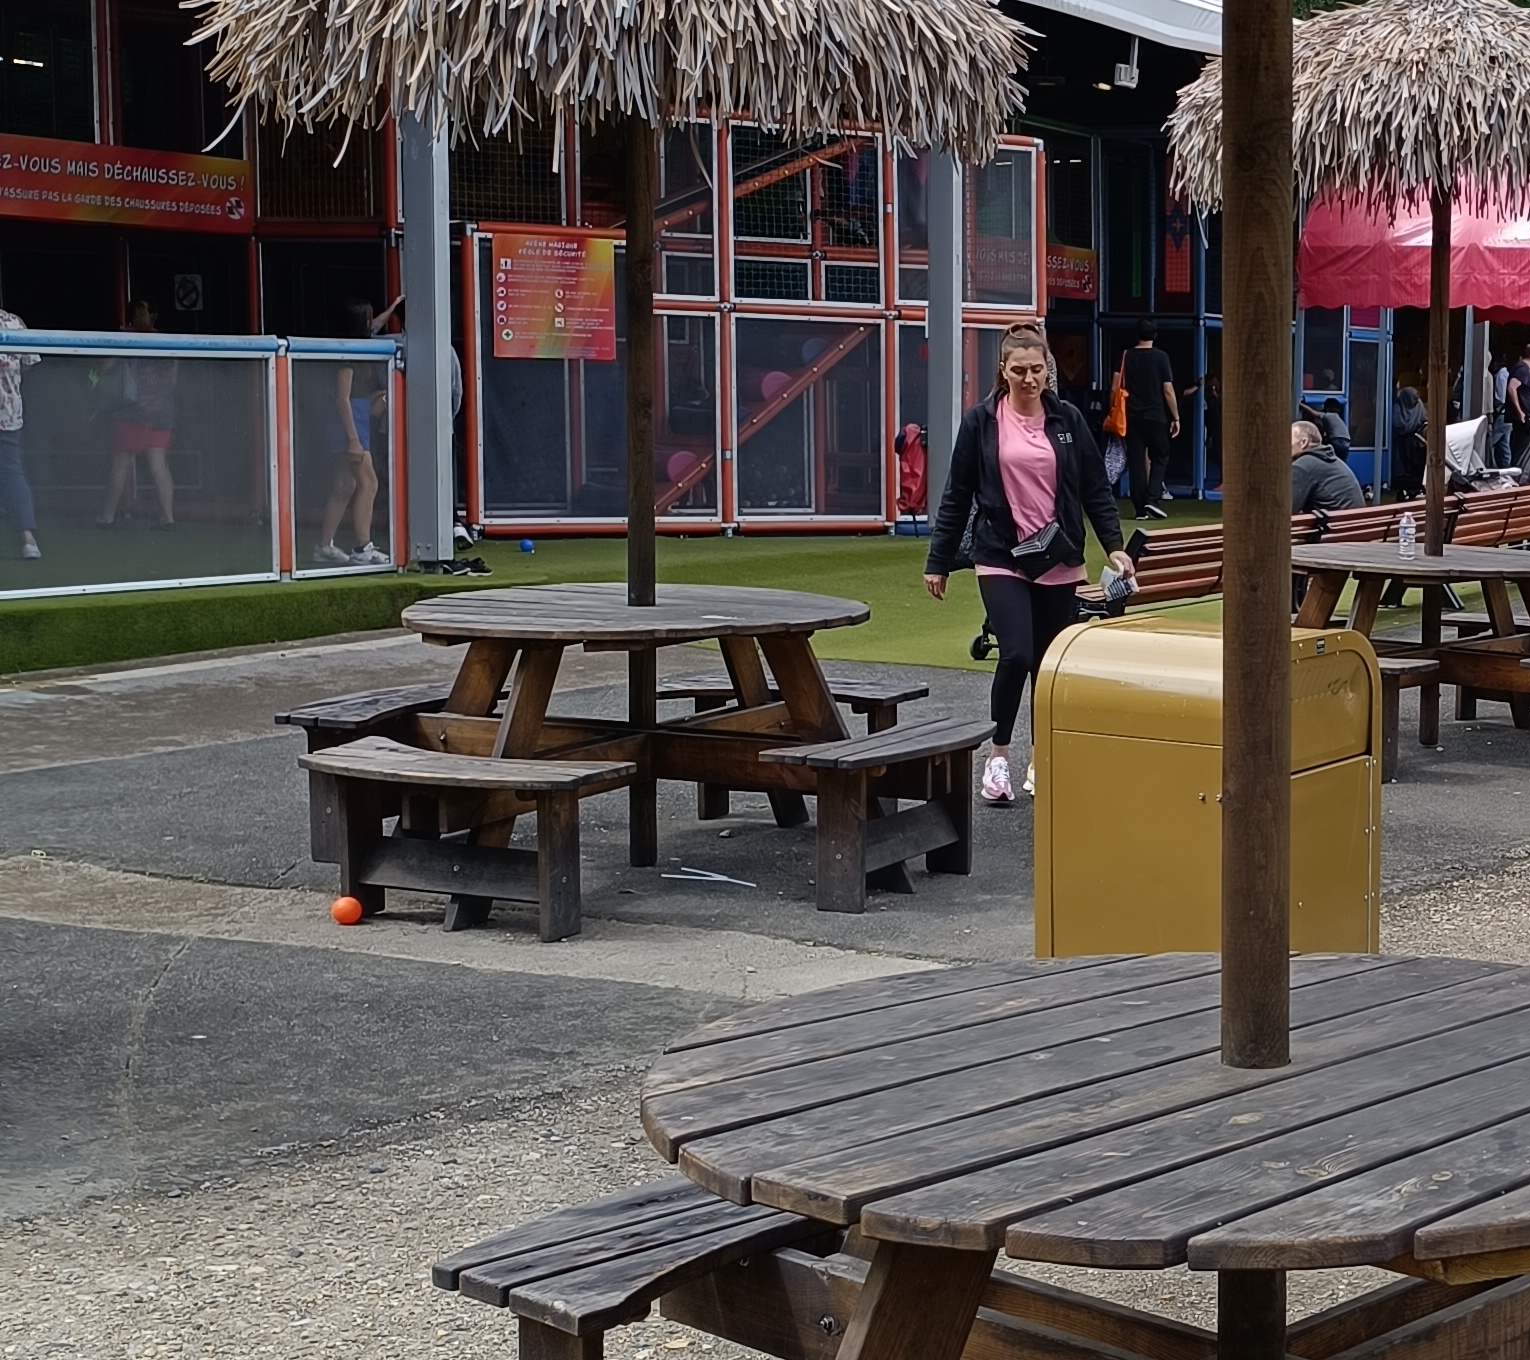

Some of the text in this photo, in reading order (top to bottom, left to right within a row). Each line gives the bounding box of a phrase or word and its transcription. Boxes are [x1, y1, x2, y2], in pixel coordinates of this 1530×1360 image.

[0, 154, 61, 174] Z-VOUS
[66, 159, 99, 178] MAIS
[104, 160, 237, 190] DÉCHAUSSEZ-VOUS
[41, 190, 60, 202] PAS
[61, 192, 72, 203] LA
[74, 193, 102, 206] GARDE
[104, 195, 122, 207] DES
[124, 197, 177, 212] CHAUSSURES
[179, 200, 222, 216] DÉPOSÉES
